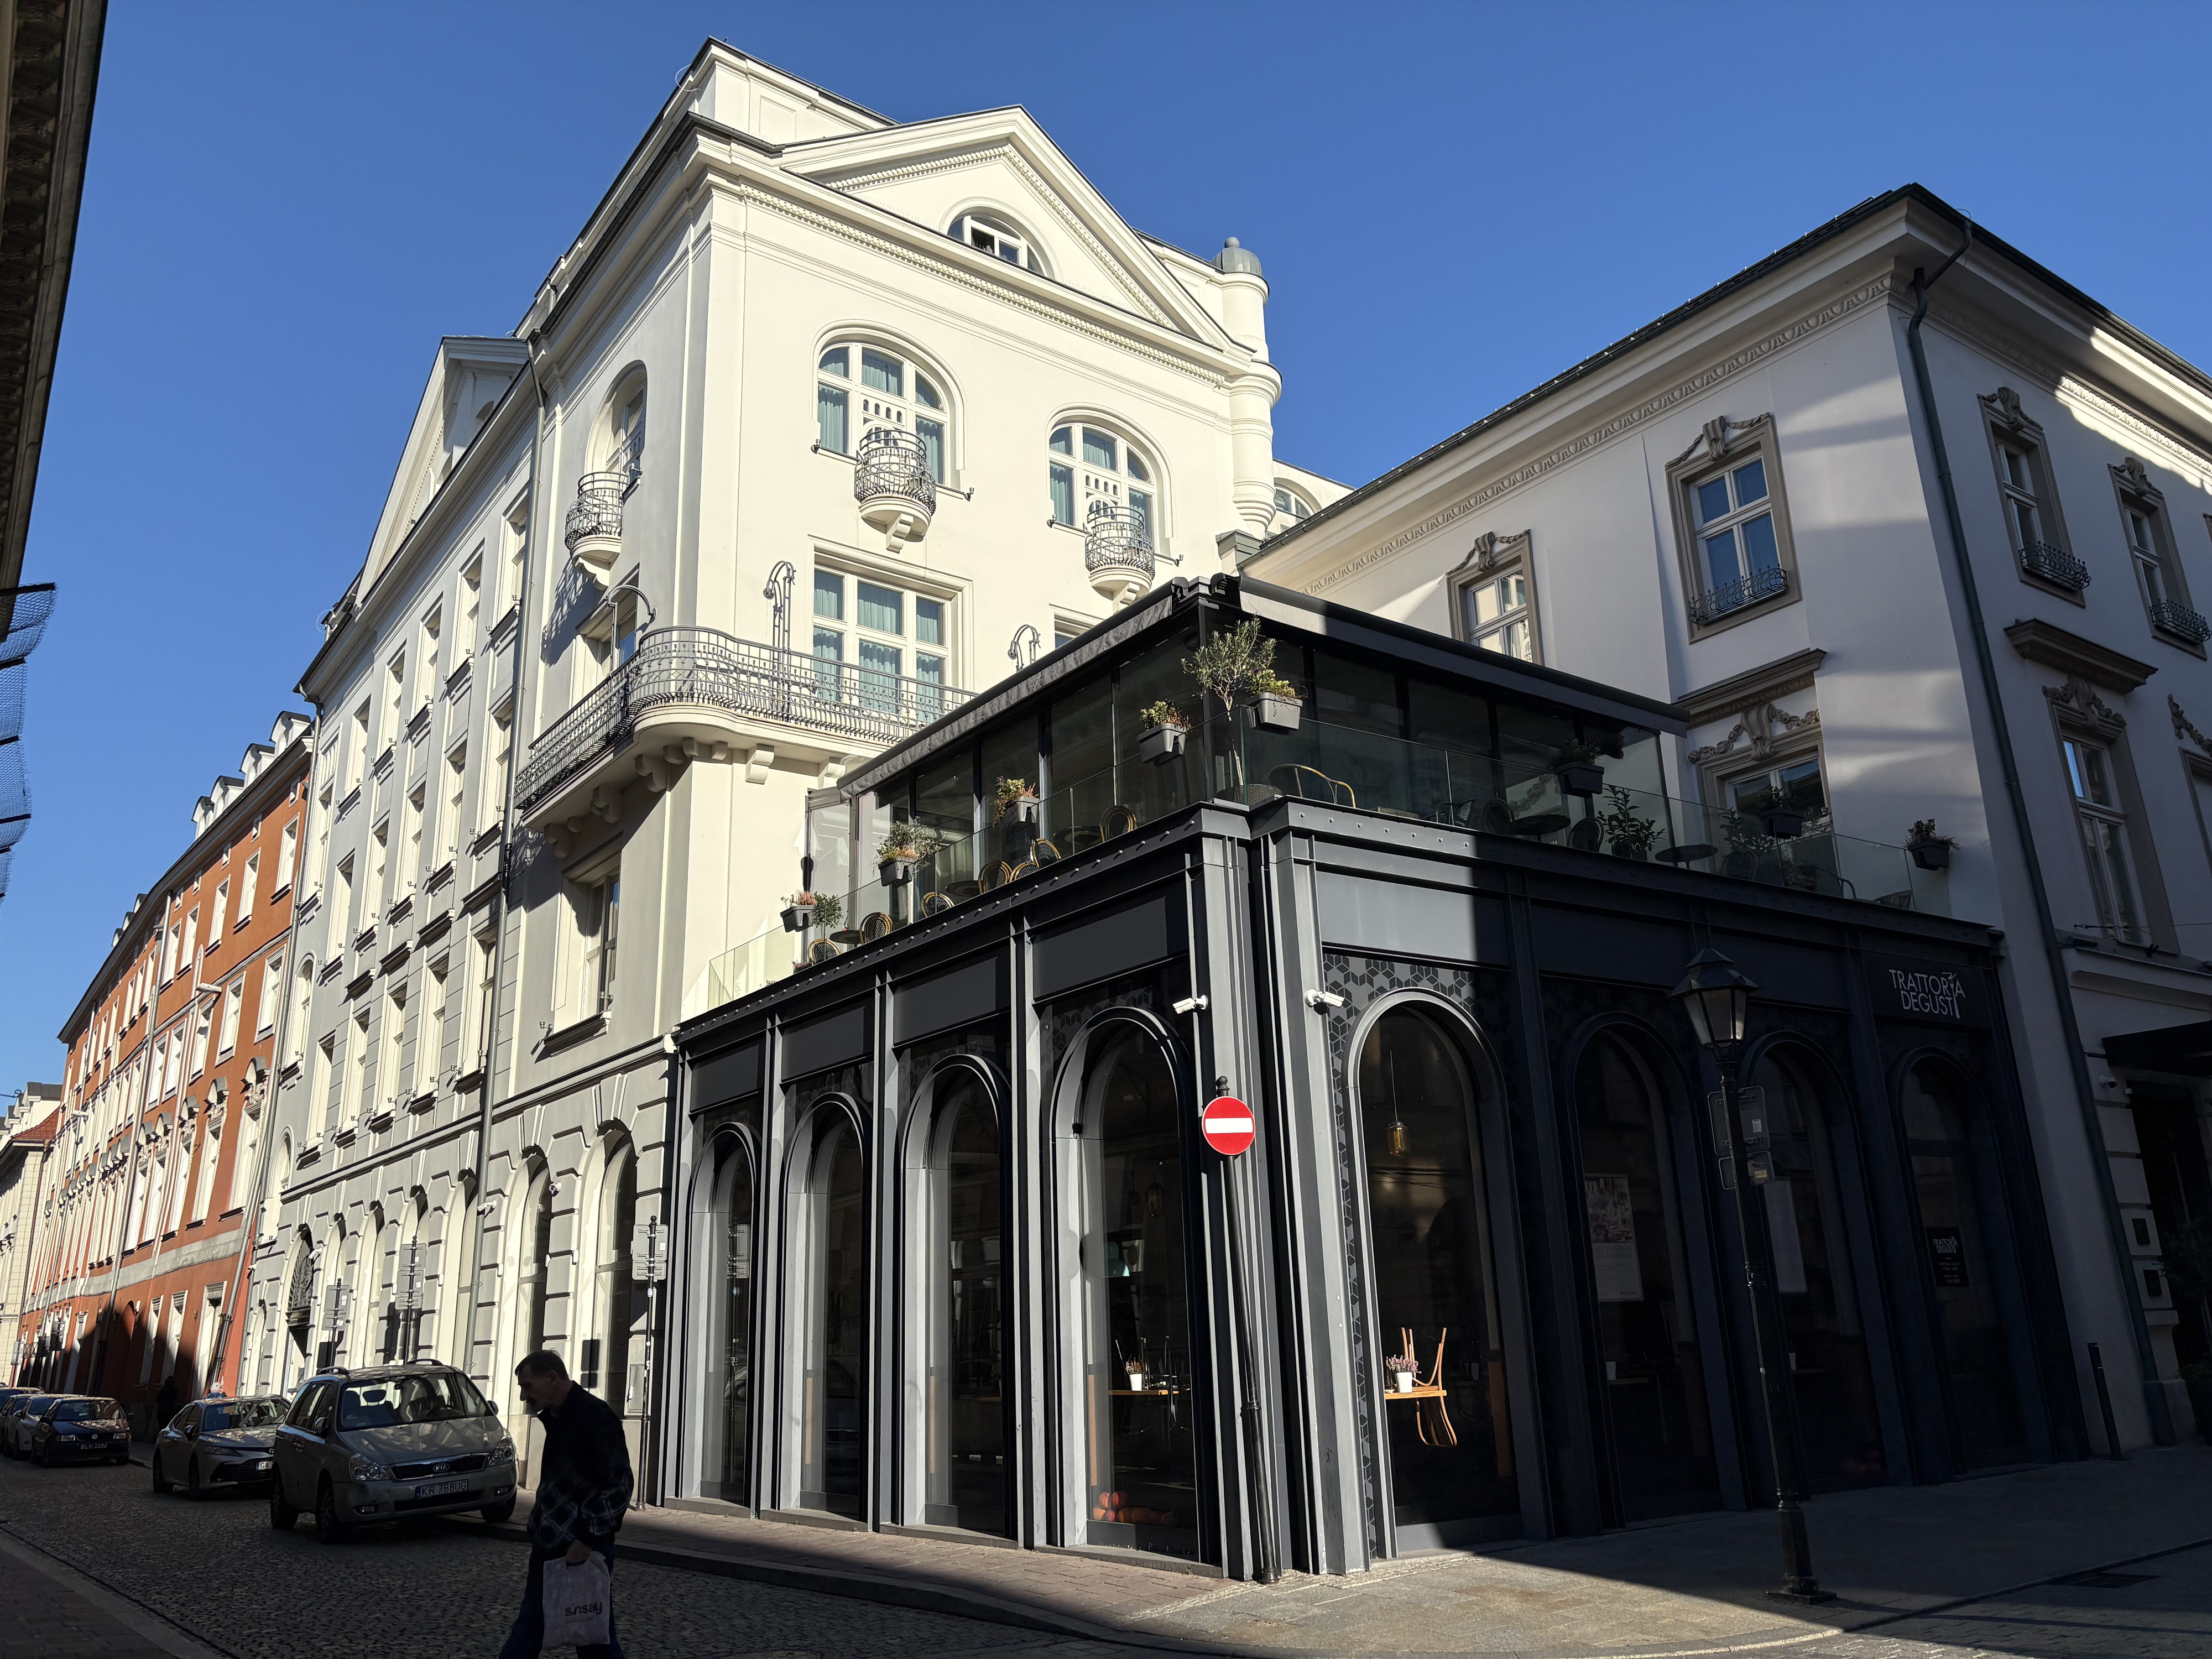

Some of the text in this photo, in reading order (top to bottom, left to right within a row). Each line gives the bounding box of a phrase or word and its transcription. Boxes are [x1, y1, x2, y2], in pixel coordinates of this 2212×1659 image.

[1889, 969, 1966, 998] TRATTORIA
[422, 1481, 466, 1496] KR 788UG
